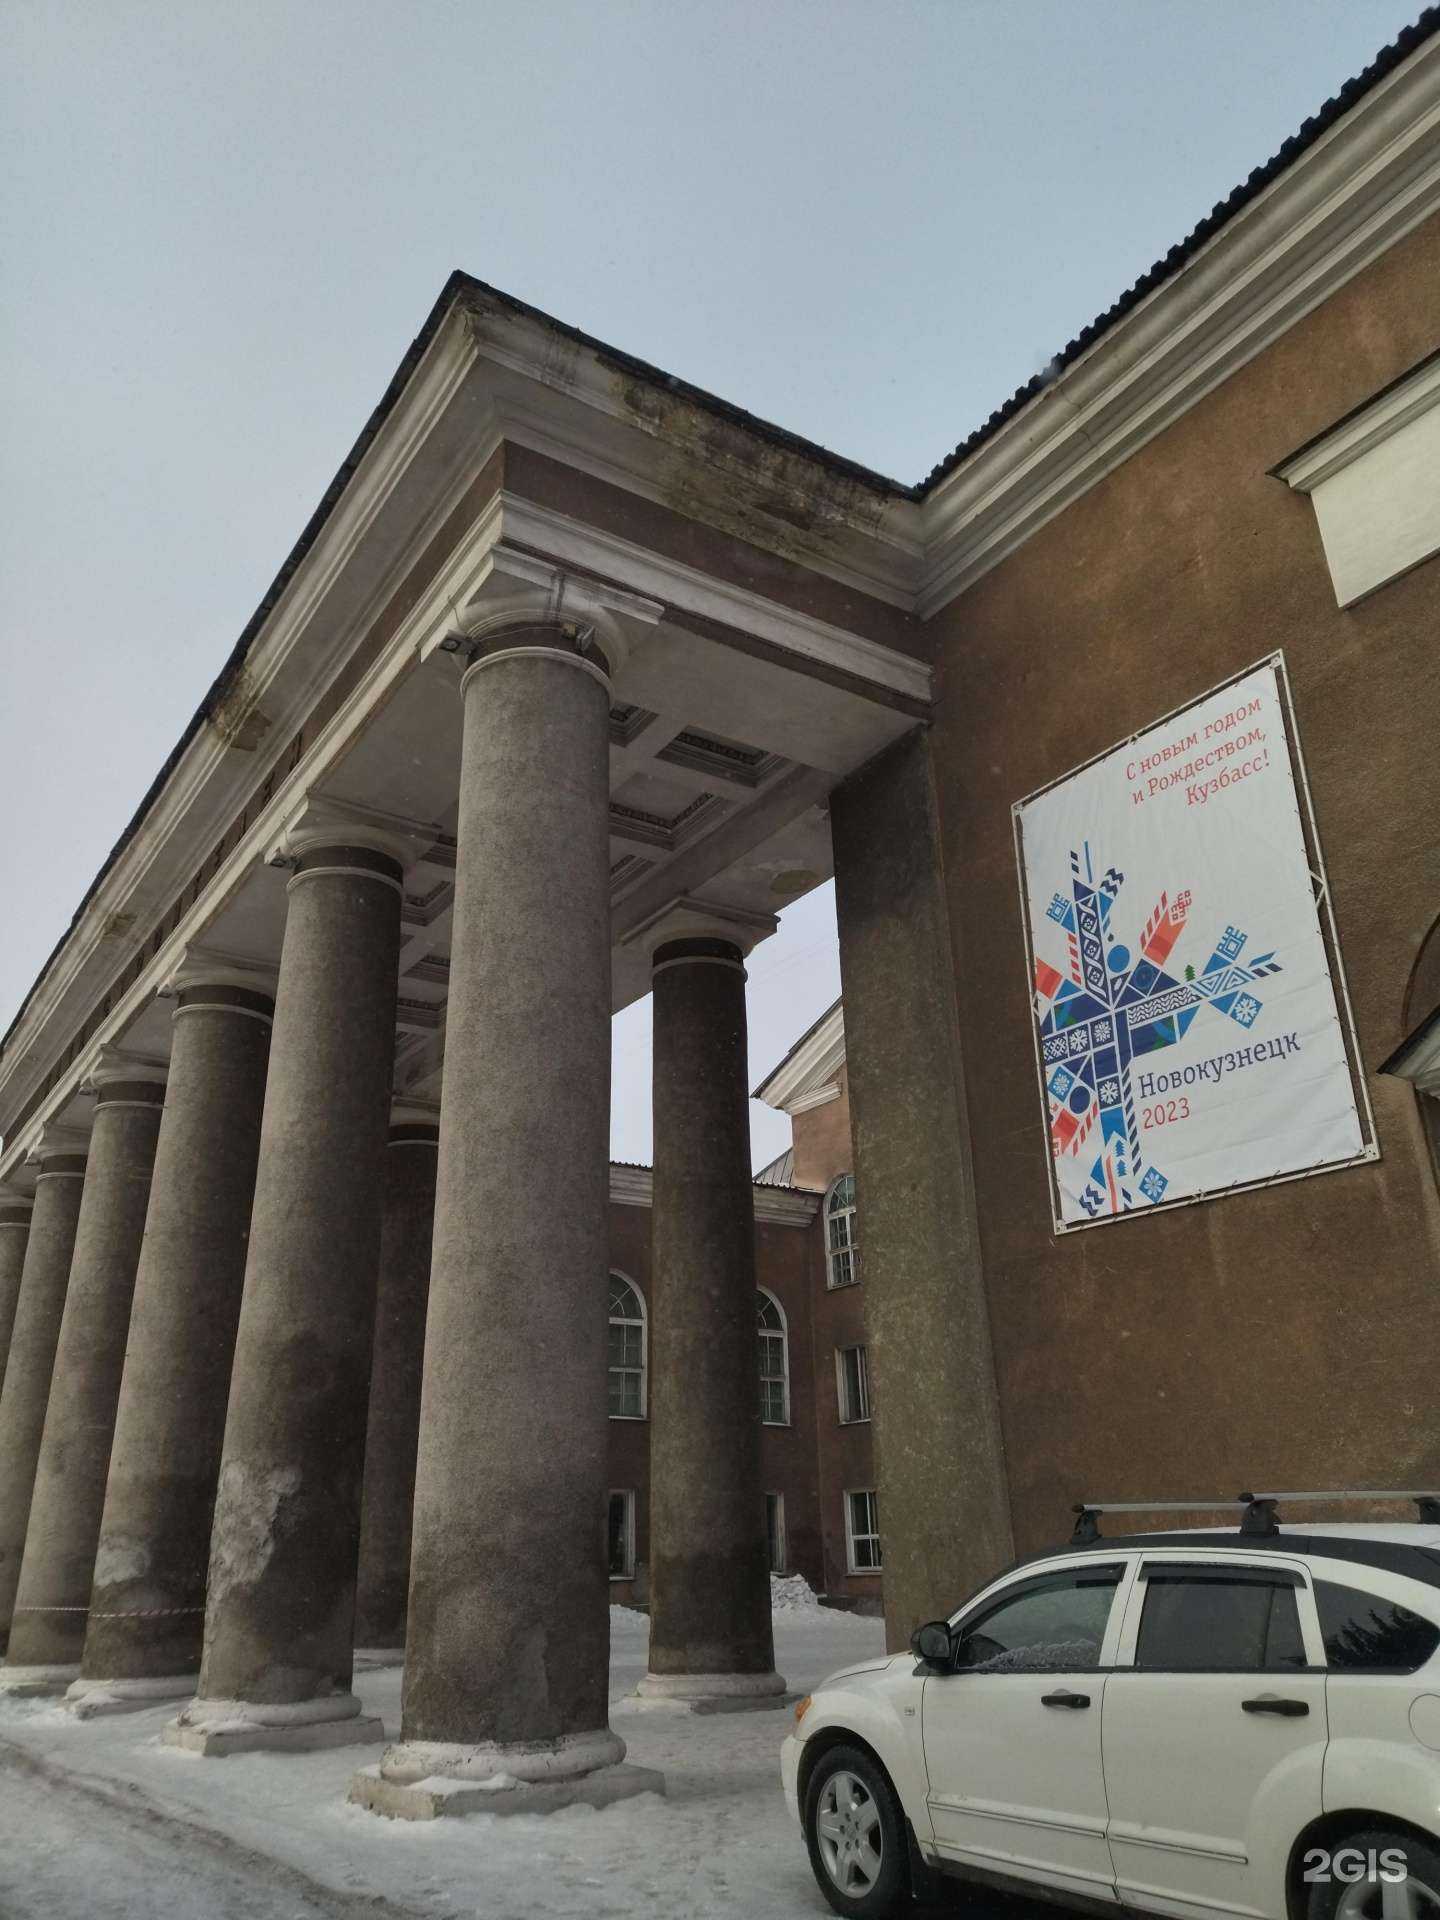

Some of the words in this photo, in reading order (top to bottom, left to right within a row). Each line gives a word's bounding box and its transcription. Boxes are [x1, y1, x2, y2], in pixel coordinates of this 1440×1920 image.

[1126, 762, 1137, 780] С
[1139, 733, 1200, 774] новым
[1203, 698, 1262, 740] годом
[1132, 789, 1145, 804] и
[1147, 727, 1267, 797] Рождеством,
[1185, 749, 1270, 806] Кузбасс!
[1138, 1032, 1301, 1099] Новокузнецк
[1142, 1097, 1191, 1130] 2023
